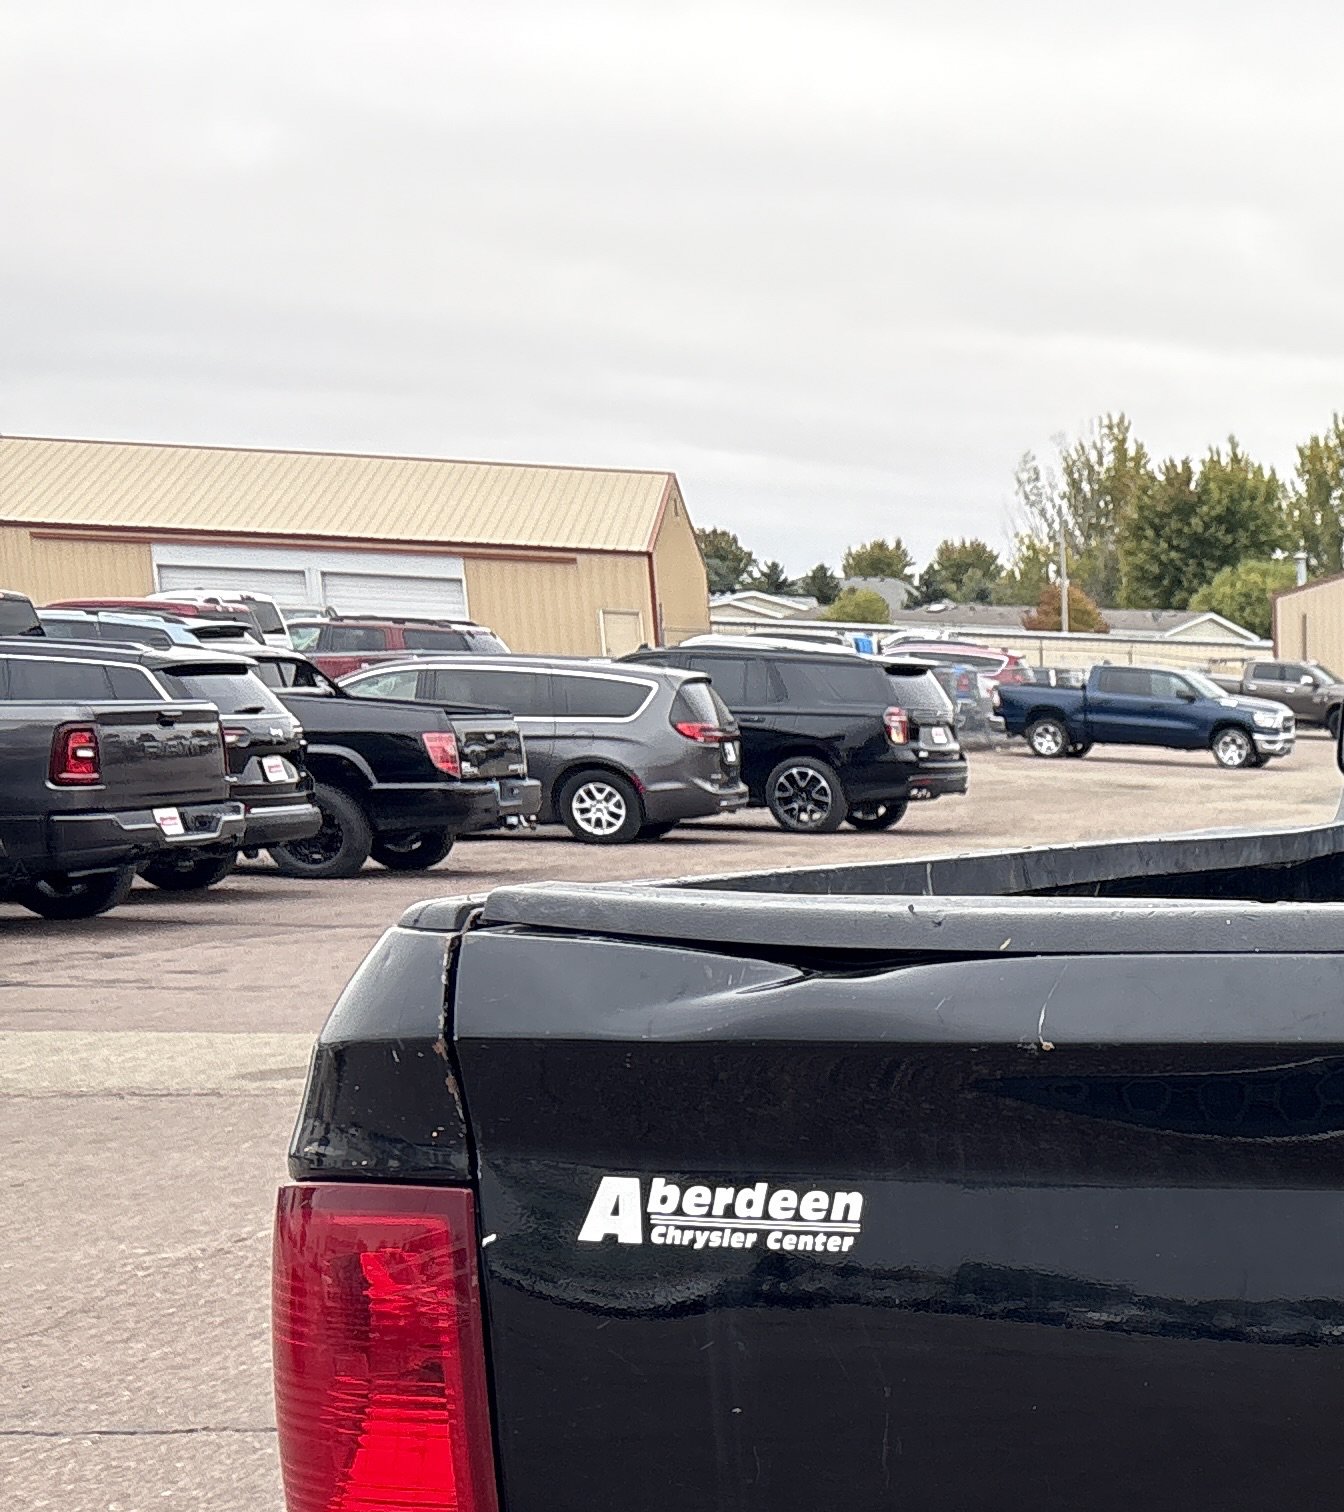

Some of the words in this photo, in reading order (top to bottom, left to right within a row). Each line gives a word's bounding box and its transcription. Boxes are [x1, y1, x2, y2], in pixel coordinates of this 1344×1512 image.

[577, 1176, 864, 1244] Aberdeen
[650, 1225, 758, 1250] Chrysler
[766, 1230, 855, 1252] Center
